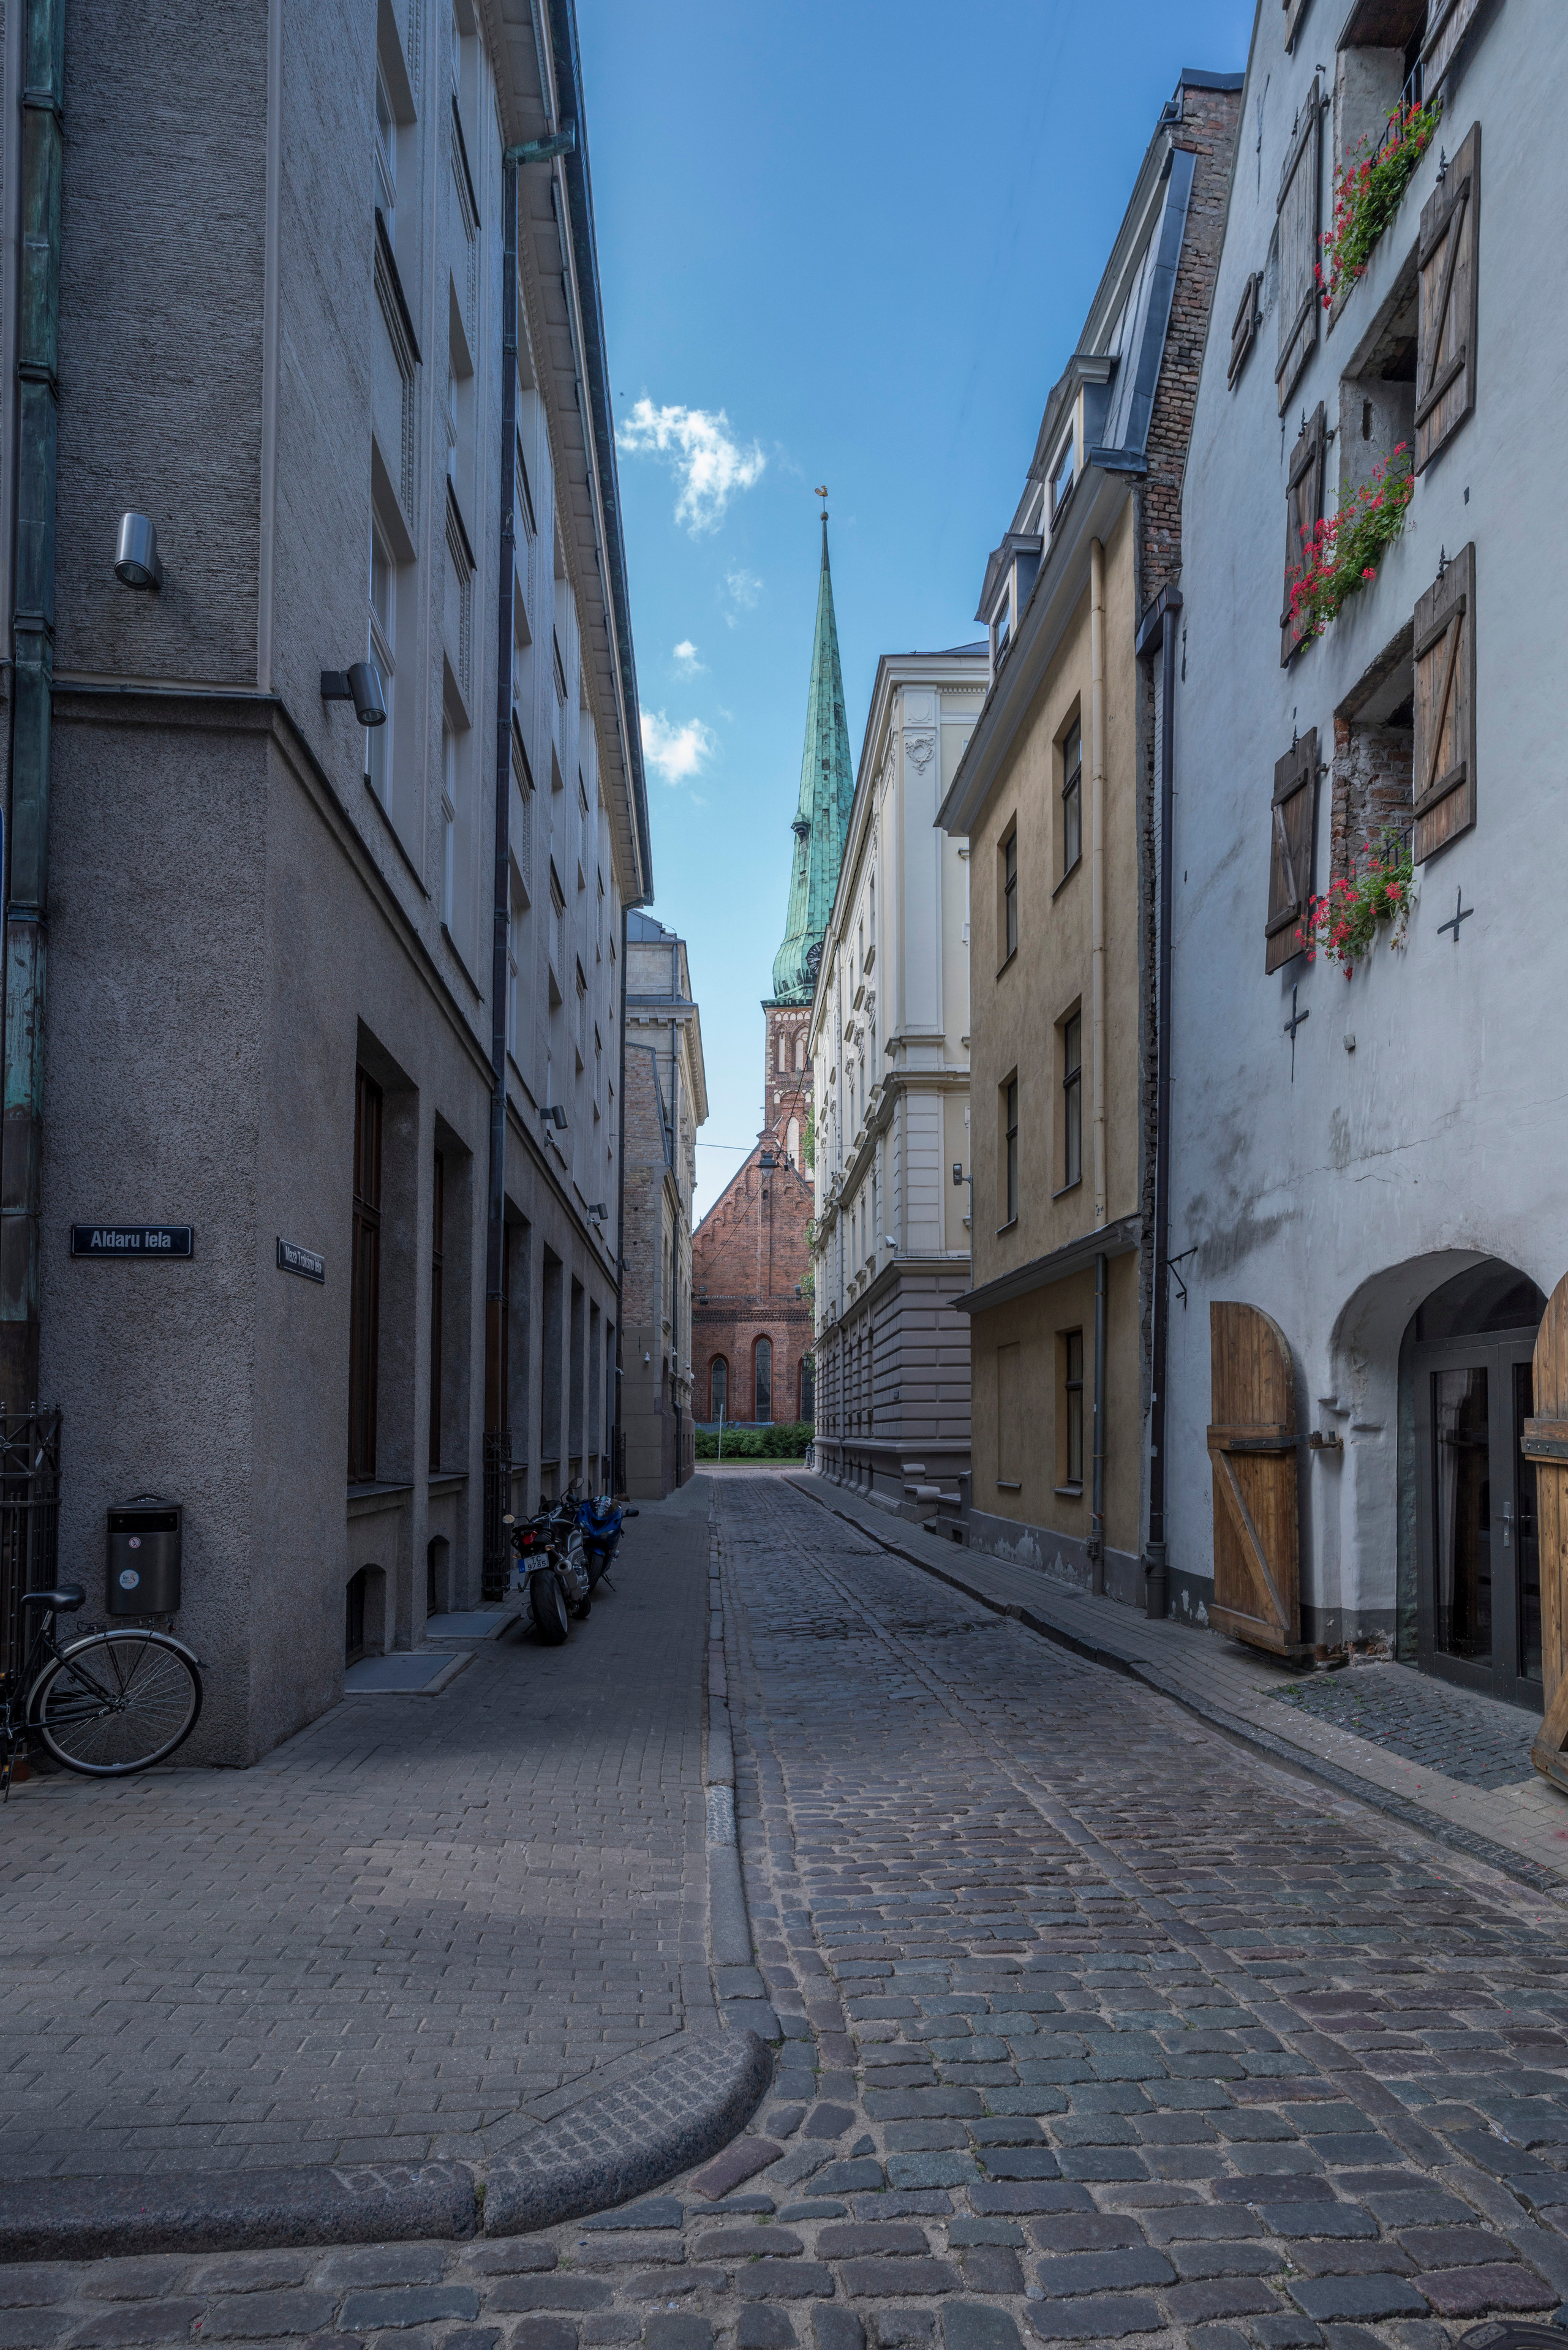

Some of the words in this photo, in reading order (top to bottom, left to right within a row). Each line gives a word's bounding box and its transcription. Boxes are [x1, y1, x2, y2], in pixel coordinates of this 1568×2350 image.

[91, 1231, 140, 1248] Aldaru
[145, 1232, 172, 1248] iela
[285, 1246, 297, 1264] Mazā
[527, 1561, 546, 1570] 9785
